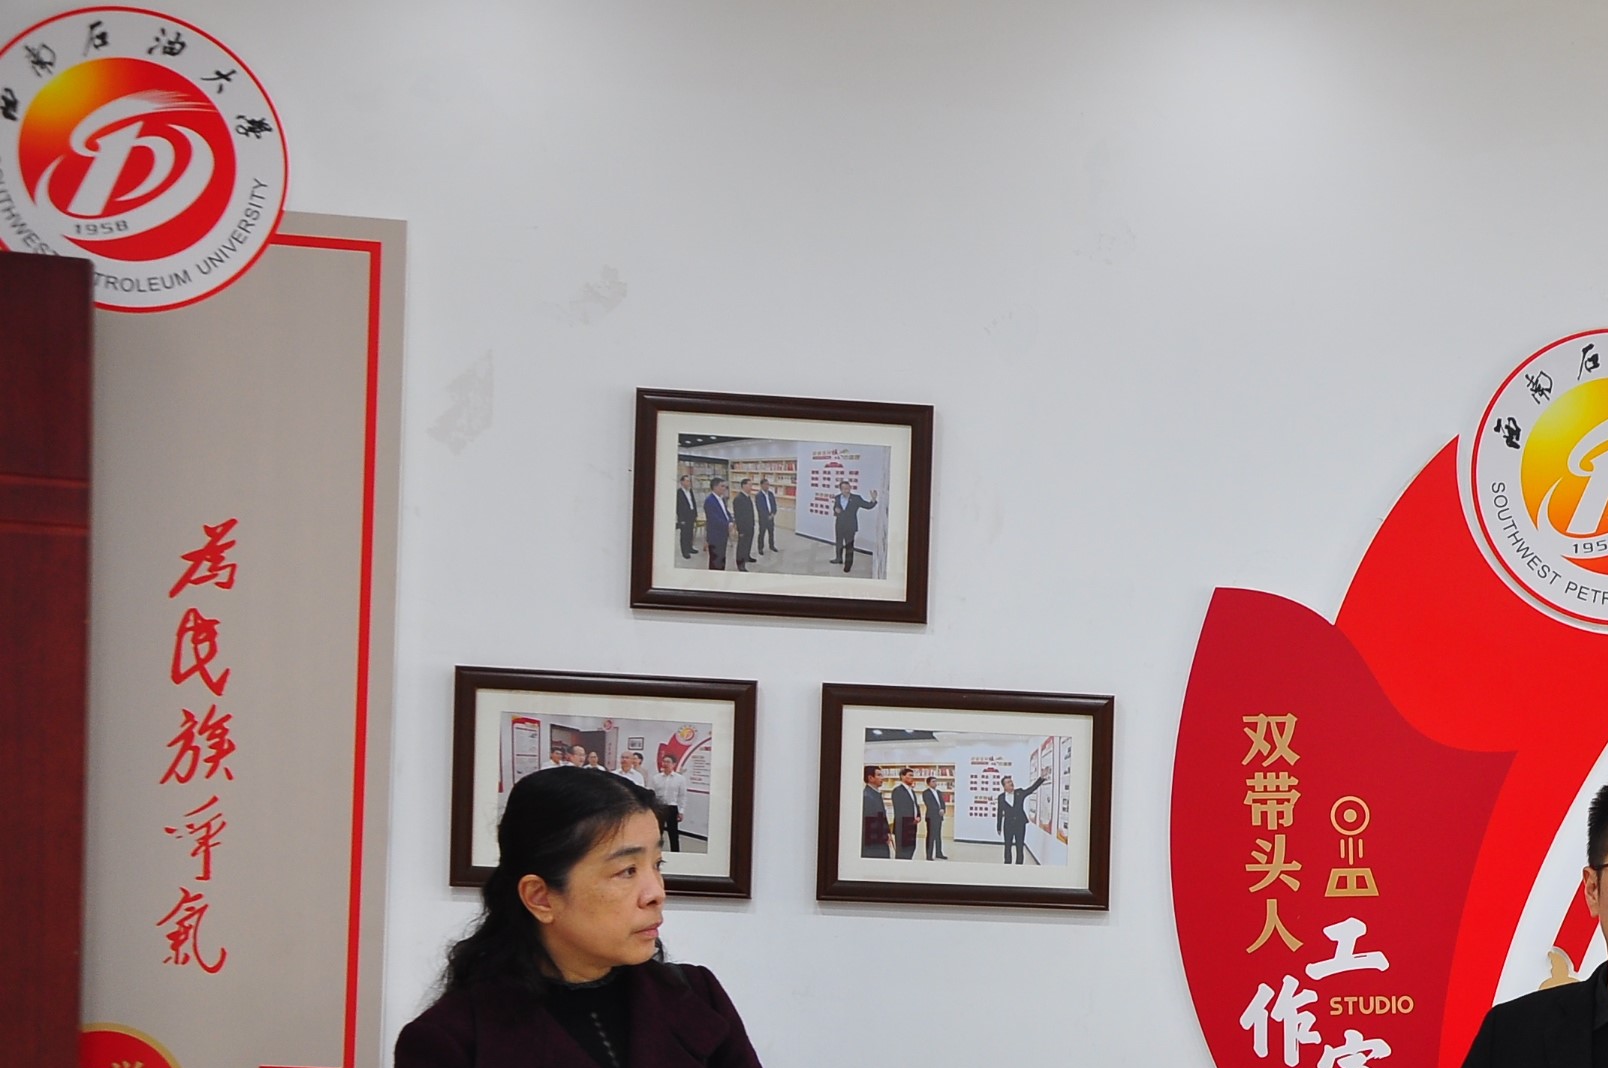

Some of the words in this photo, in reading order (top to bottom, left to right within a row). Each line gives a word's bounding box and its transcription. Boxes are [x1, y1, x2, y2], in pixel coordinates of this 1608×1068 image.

[75, 220, 128, 236] 1958
[196, 177, 269, 276] UNIVERSITY
[1491, 481, 1562, 586] SOUTHWEST
[1241, 712, 1304, 954] 双带头人
[1329, 995, 1415, 1017] STUDIO
